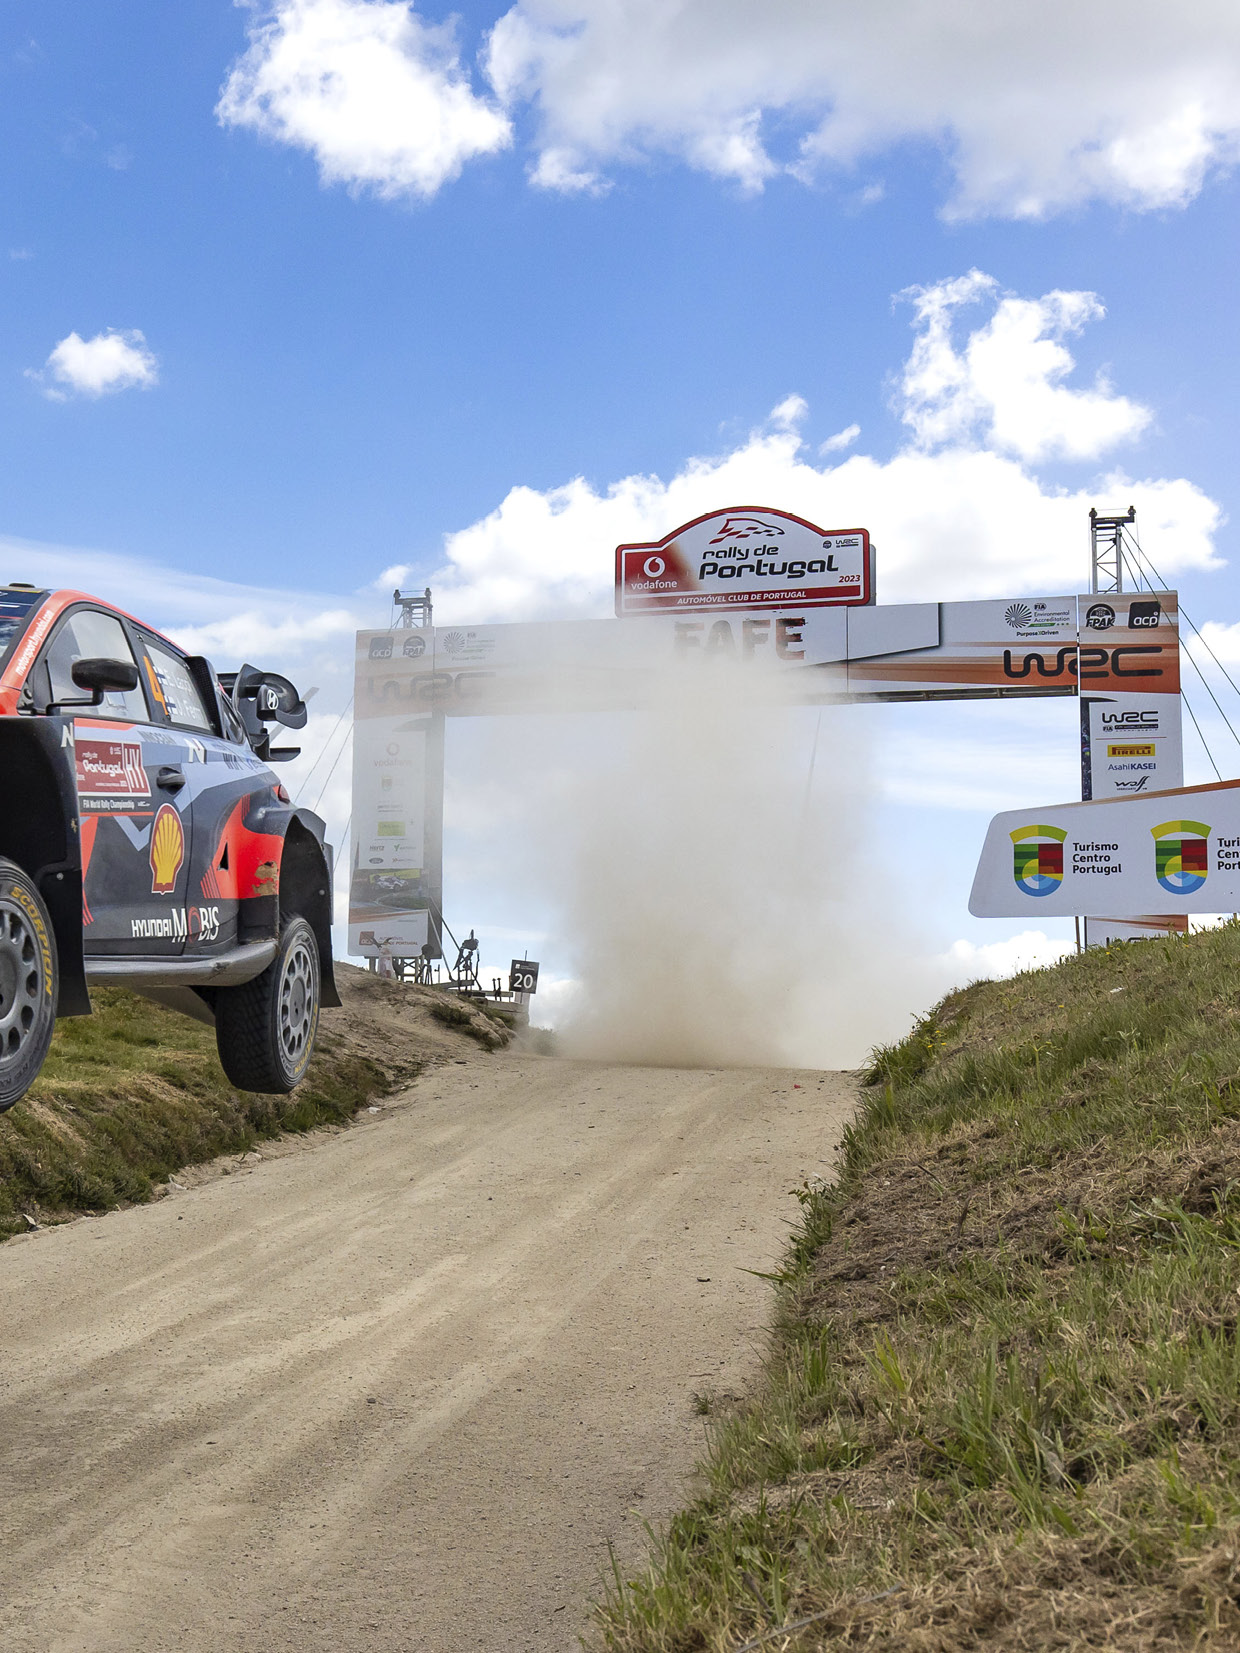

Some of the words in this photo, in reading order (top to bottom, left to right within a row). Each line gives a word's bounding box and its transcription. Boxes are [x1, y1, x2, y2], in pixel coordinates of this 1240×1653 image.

[702, 546, 750, 561] rally
[753, 545, 779, 557] de
[699, 554, 839, 580] Portugal
[631, 579, 678, 590] vodafone
[838, 574, 861, 584] 2023
[677, 595, 726, 605] AUTOMÓVEL
[728, 593, 749, 602] CLUB
[750, 593, 762, 601] DE
[763, 590, 807, 600] PORTUGAL
[1134, 614, 1158, 626] acp
[674, 617, 807, 661] FAFE
[1004, 646, 1163, 678] WRC
[1102, 711, 1158, 723] WRC
[1111, 746, 1151, 755] PIRELLI
[83, 760, 123, 777] Portugal
[1072, 842, 1118, 852] Turismo
[1072, 853, 1110, 864] Centro
[1072, 863, 1122, 876] Portugal
[131, 919, 172, 938] HYUNDAI
[171, 906, 219, 944] MOBIS
[10, 885, 54, 996] SCORPION
[513, 973, 534, 989] 20
